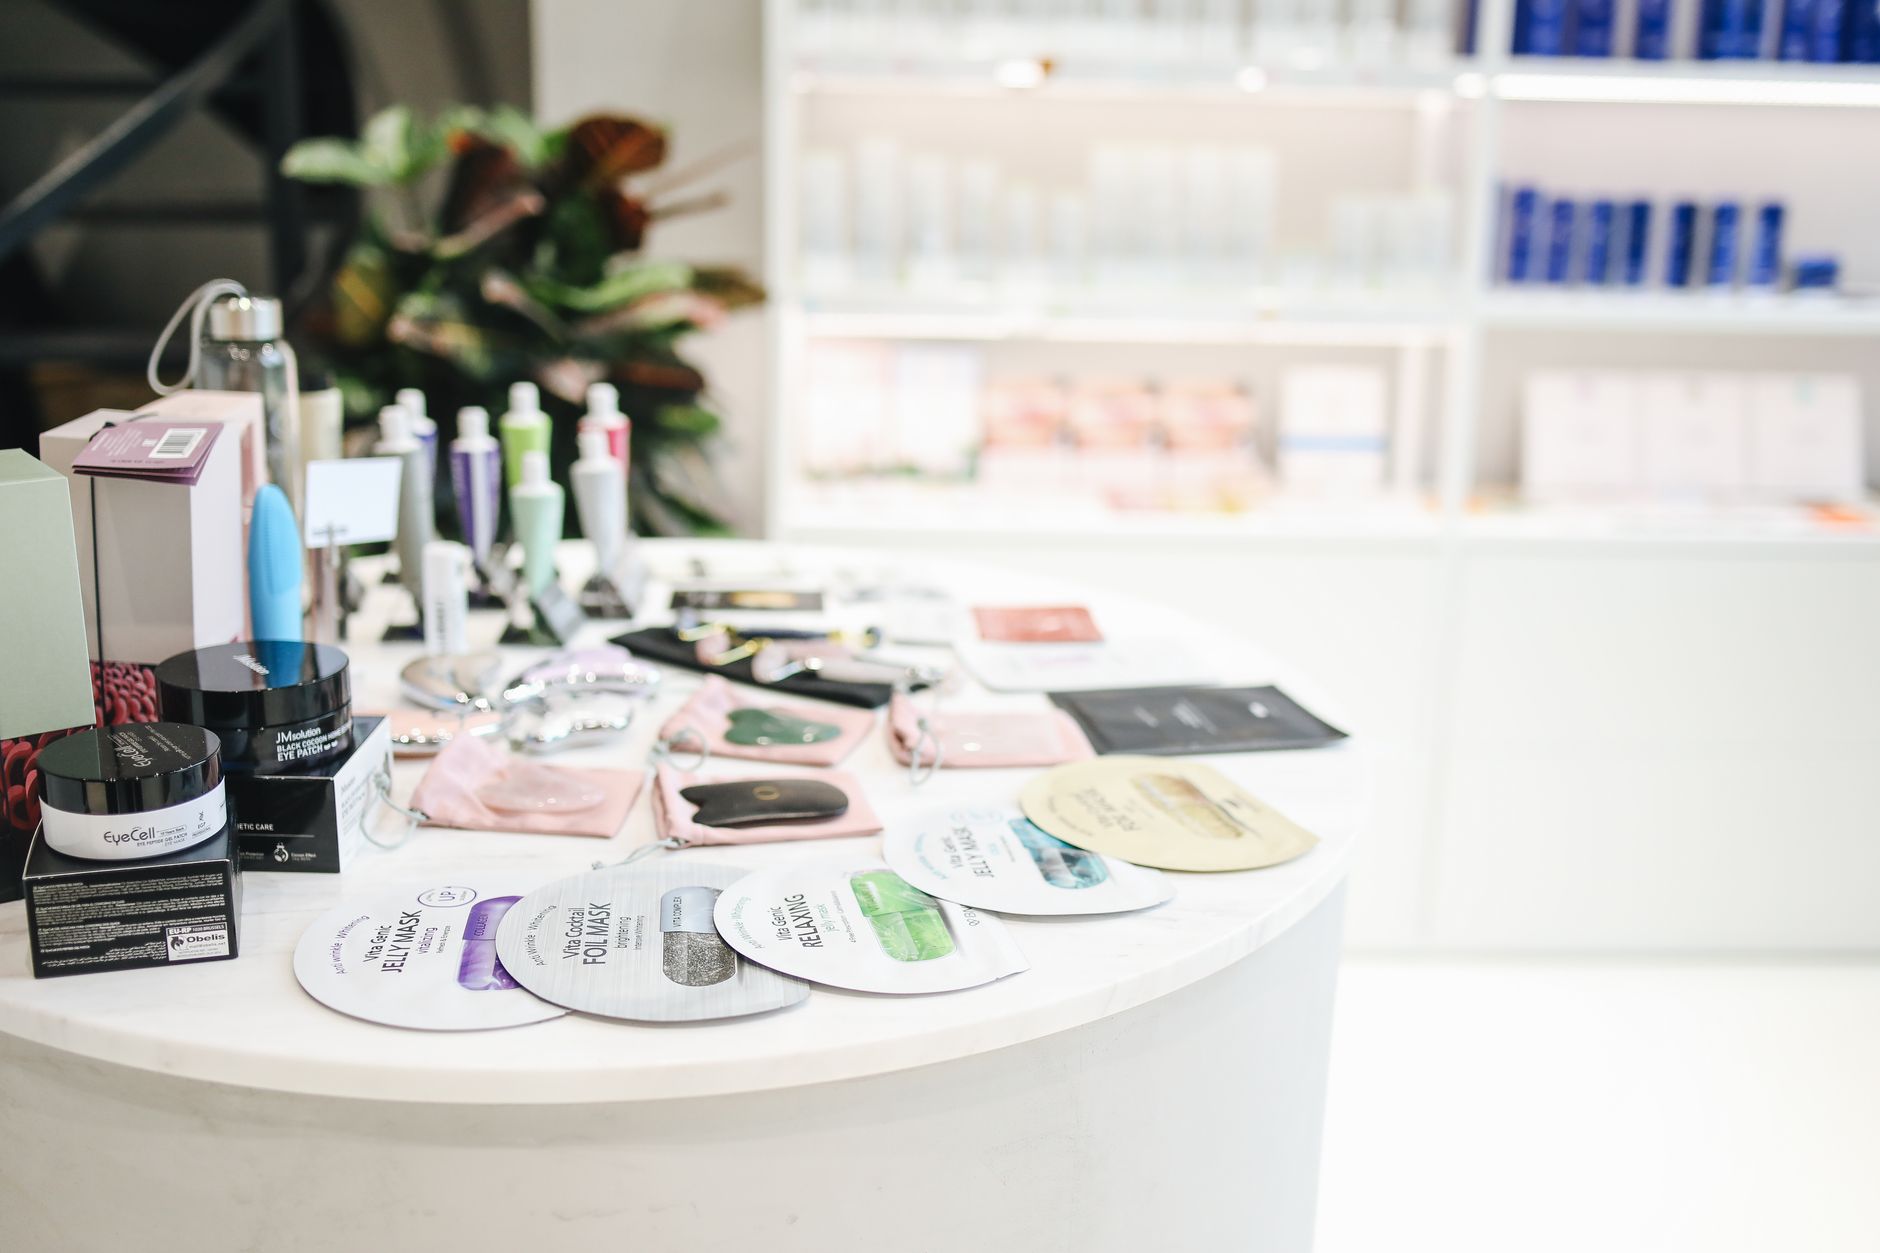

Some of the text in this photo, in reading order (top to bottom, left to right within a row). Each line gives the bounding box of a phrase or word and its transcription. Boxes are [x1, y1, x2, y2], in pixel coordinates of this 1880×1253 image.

[276, 727, 321, 744] JMsolution
[277, 741, 301, 752] BLACK
[302, 734, 328, 748] COCOON
[278, 744, 323, 762] EYE PATCH
[104, 827, 155, 846] EyeCell
[966, 853, 995, 878] JELLY
[672, 896, 682, 928] VITA COMPLEX
[768, 906, 792, 940] Vita Genic
[784, 894, 824, 948] RELAXING
[186, 934, 225, 942] Obelis
[363, 925, 392, 962] Vita Genic
[381, 910, 422, 972] JELLY MASK
[562, 907, 586, 960] Vita Cocktail
[583, 902, 612, 965] FOIL MASK
[614, 916, 632, 949] brightening
